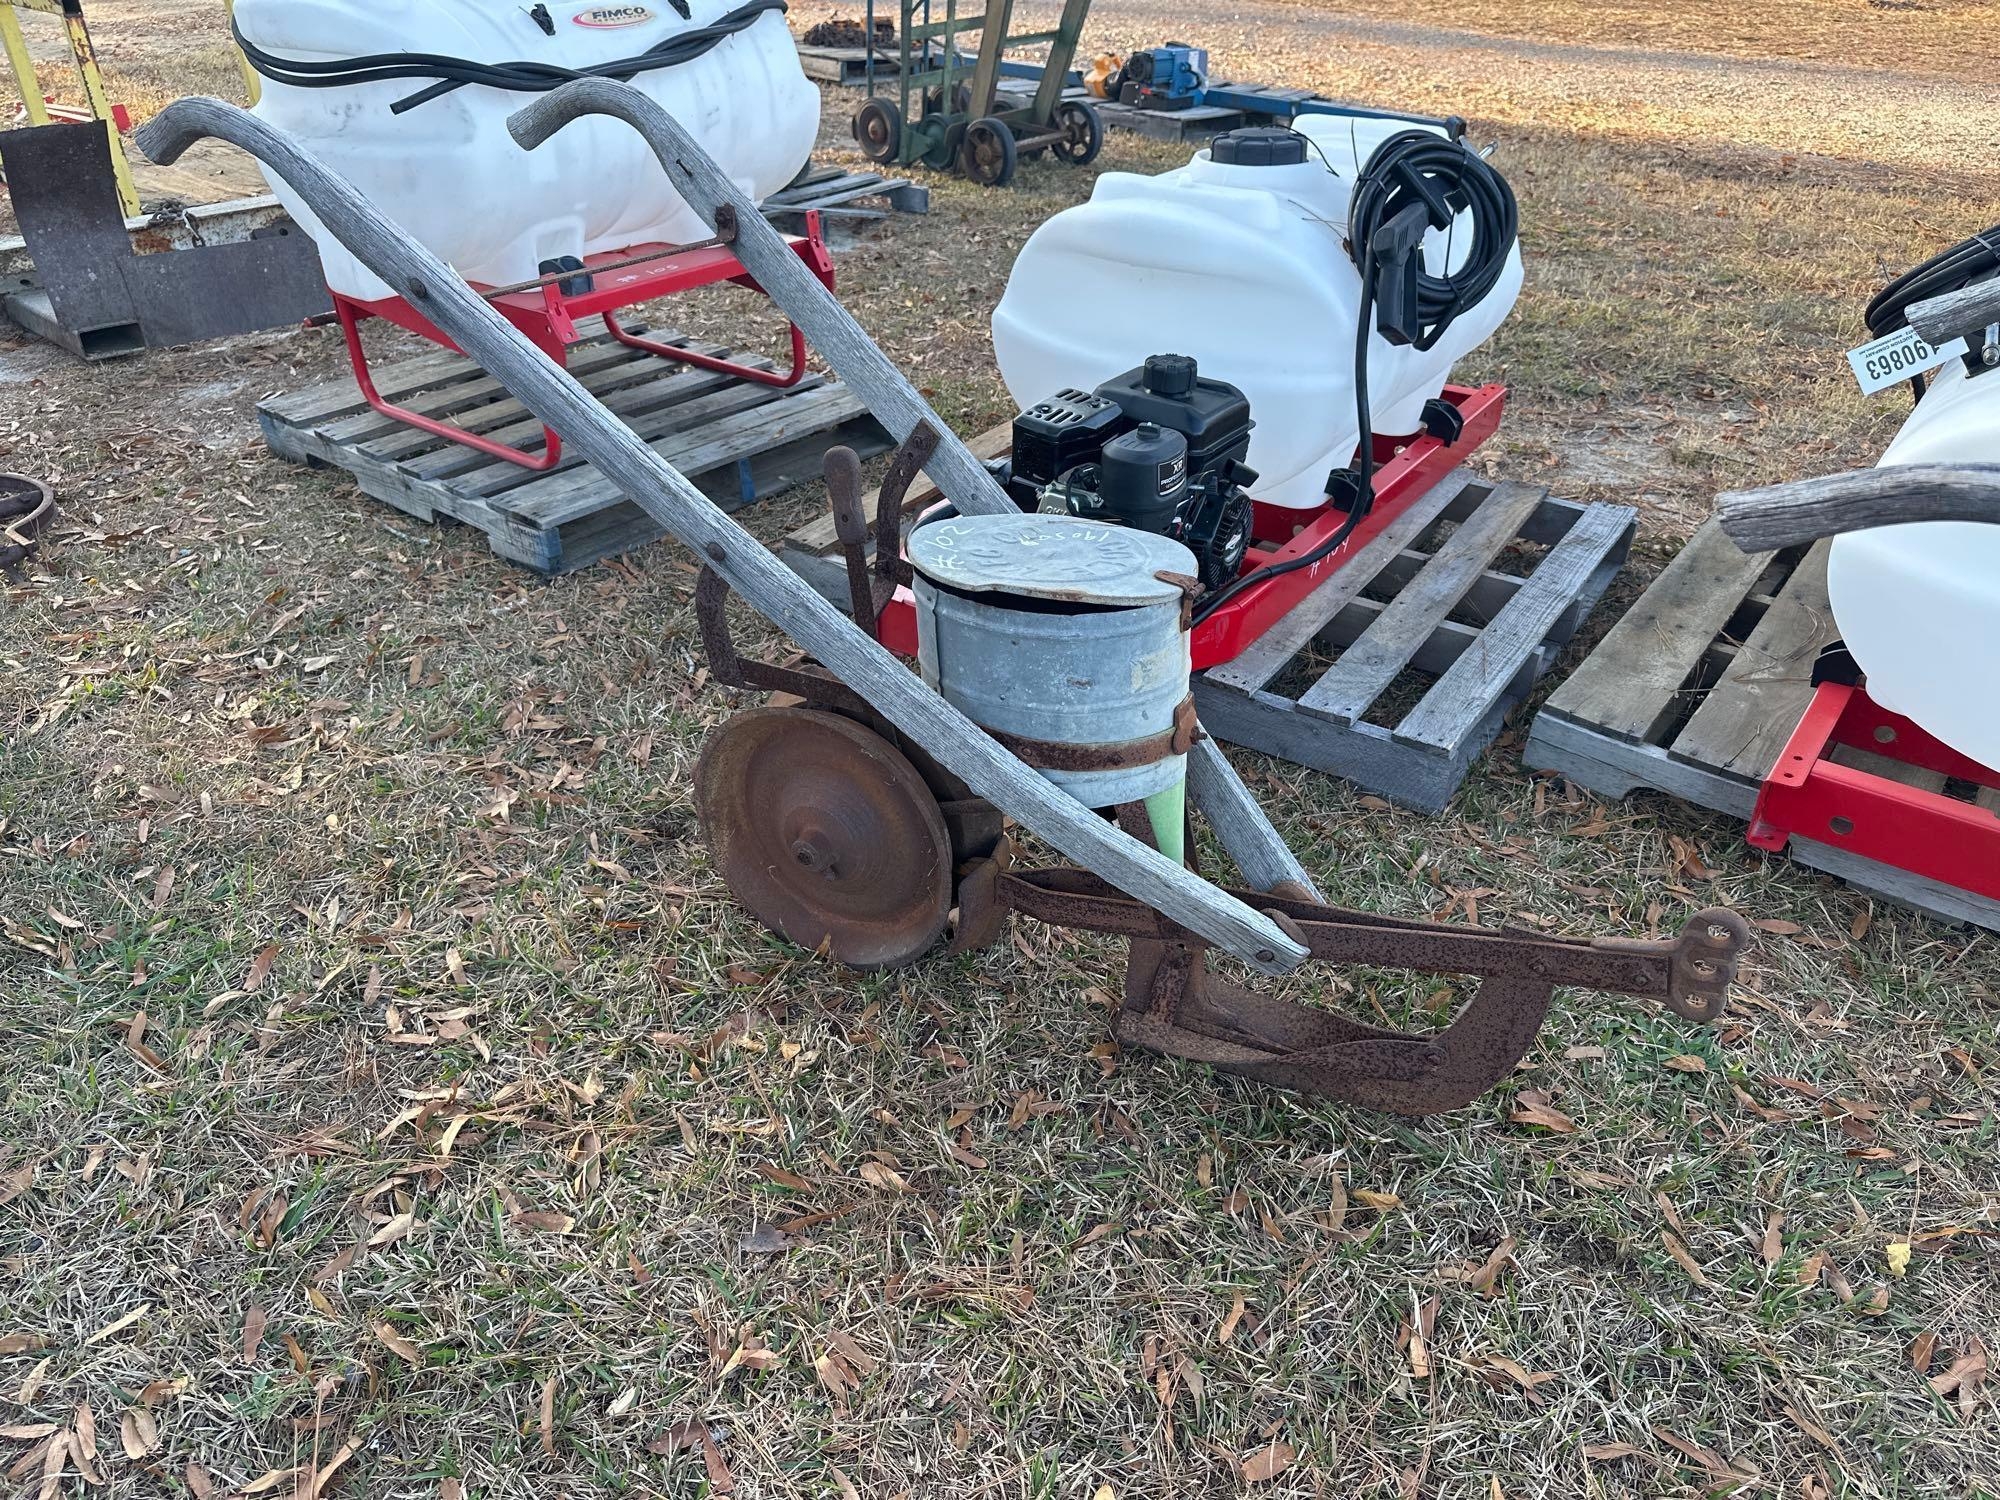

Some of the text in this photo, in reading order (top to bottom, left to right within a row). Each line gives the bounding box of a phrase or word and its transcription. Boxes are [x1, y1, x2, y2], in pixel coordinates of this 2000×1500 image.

[592, 6, 646, 20] FIMCO
[1890, 334, 1914, 347] AUCTION
[1865, 345, 1891, 358] COMPANY
